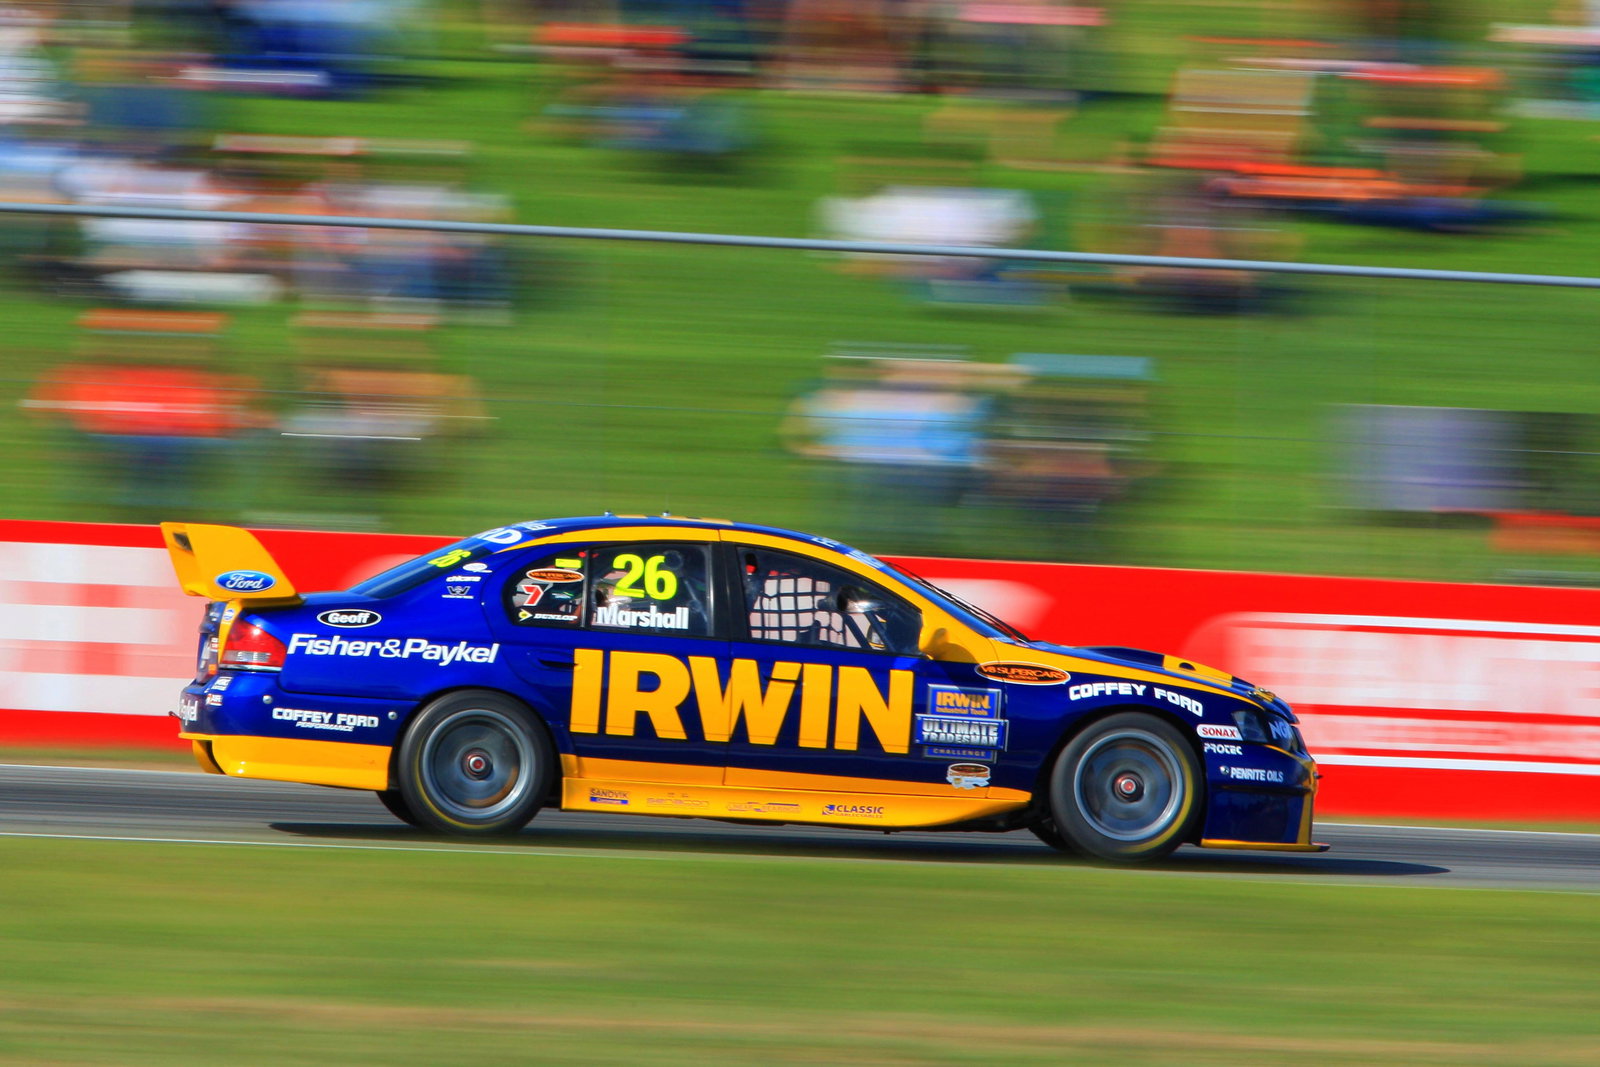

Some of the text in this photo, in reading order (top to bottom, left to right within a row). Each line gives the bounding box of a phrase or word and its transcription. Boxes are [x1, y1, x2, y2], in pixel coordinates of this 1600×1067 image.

[225, 572, 264, 590] Ford
[612, 553, 678, 600] 26
[521, 585, 544, 606] 7
[327, 612, 371, 624] Geoff
[597, 604, 689, 629] Marshall
[997, 667, 1066, 680] SUPERCARS
[569, 647, 915, 755] IRWIN
[936, 691, 991, 710] IRWIN
[1069, 682, 1203, 717] COFFEY FORD
[272, 707, 379, 728] COFFEY FORD
[296, 721, 355, 732] PERFORMANCE
[922, 717, 1000, 737] ULTIMATE
[1201, 727, 1237, 738] SONAX
[922, 731, 999, 747] TRADESMAN
[933, 748, 987, 757] CHALLENGE
[1203, 742, 1243, 756] PROTEC
[1230, 766, 1284, 783] PENRITE OILS
[590, 788, 629, 799] SANDVIK
[836, 804, 885, 815] CLASSIC
